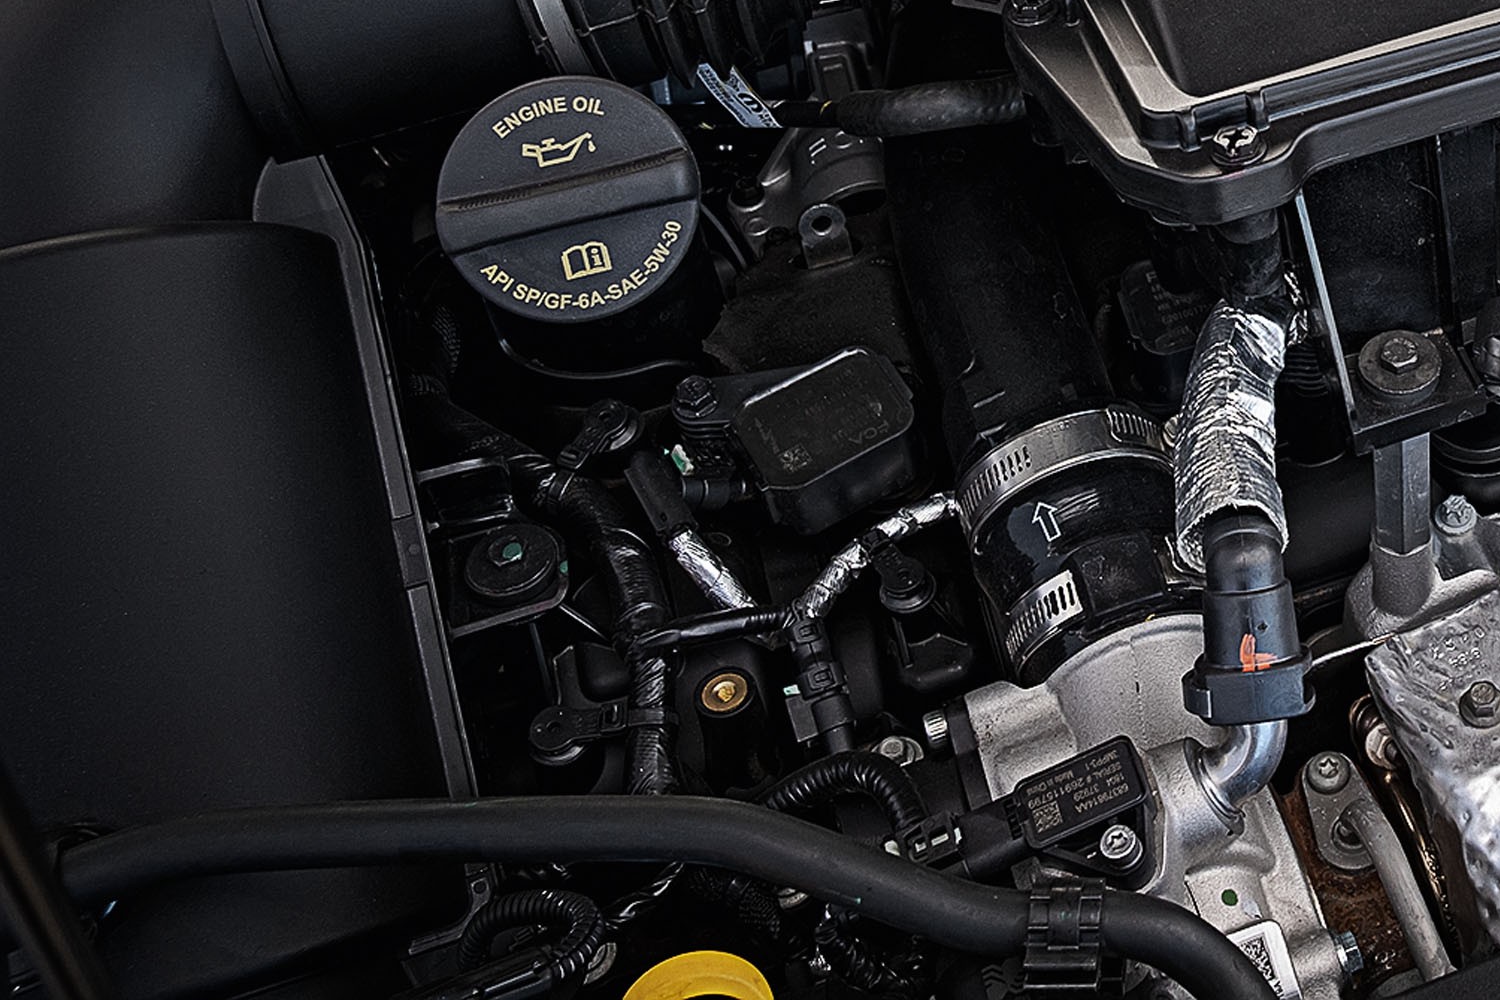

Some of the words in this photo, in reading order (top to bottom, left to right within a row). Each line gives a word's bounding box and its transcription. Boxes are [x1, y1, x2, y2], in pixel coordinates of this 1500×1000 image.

[491, 96, 568, 139] ENGINE
[572, 96, 606, 116] OIL
[480, 263, 515, 293] API
[512, 220, 682, 311] SP/GF-6A-SAE-5W-30
